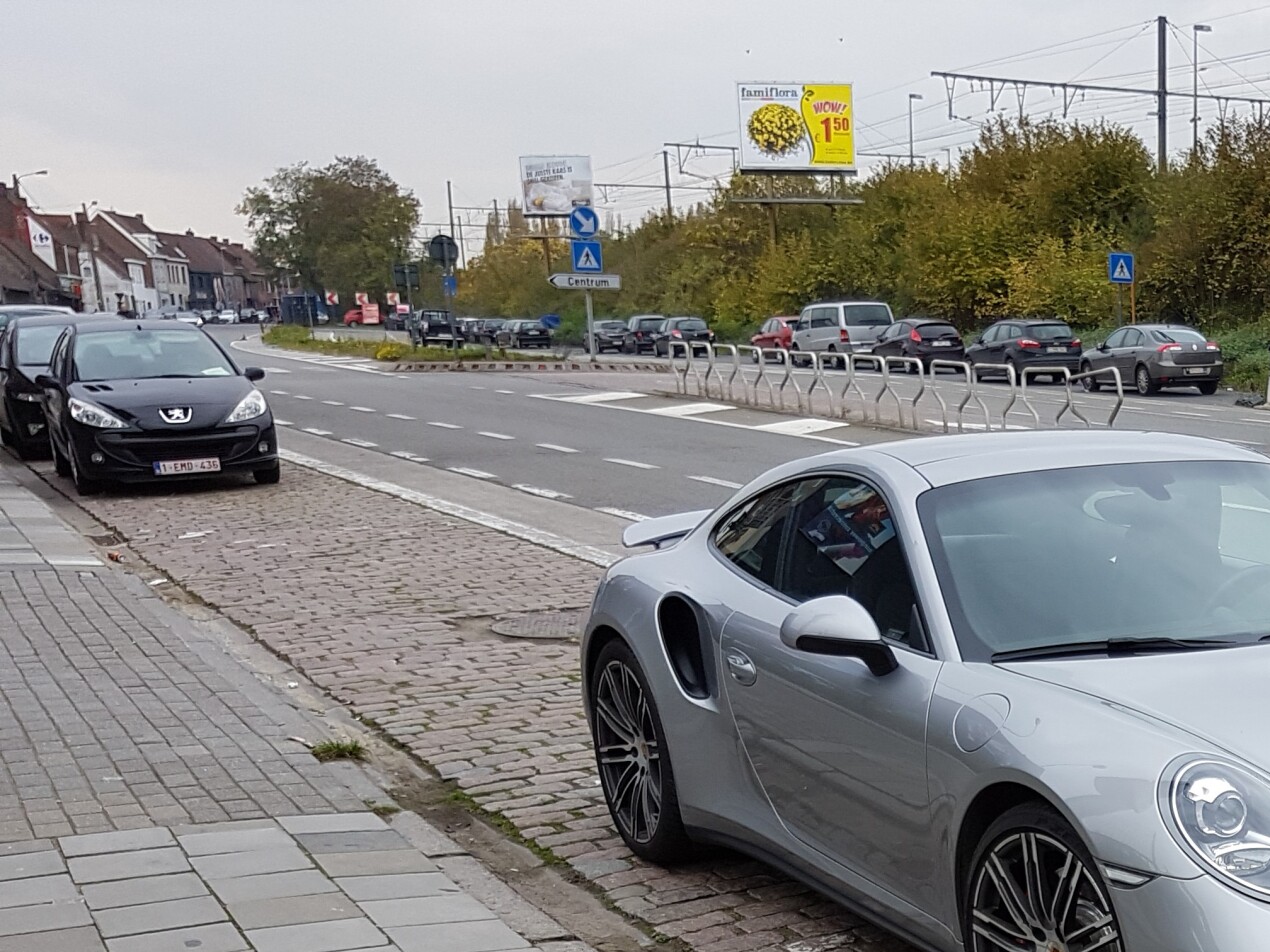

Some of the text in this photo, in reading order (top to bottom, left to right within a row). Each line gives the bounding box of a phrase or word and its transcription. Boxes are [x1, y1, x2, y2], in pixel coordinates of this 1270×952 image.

[741, 87, 798, 97] famiflora
[813, 101, 847, 115] WOW!
[568, 277, 610, 287] Centrum
